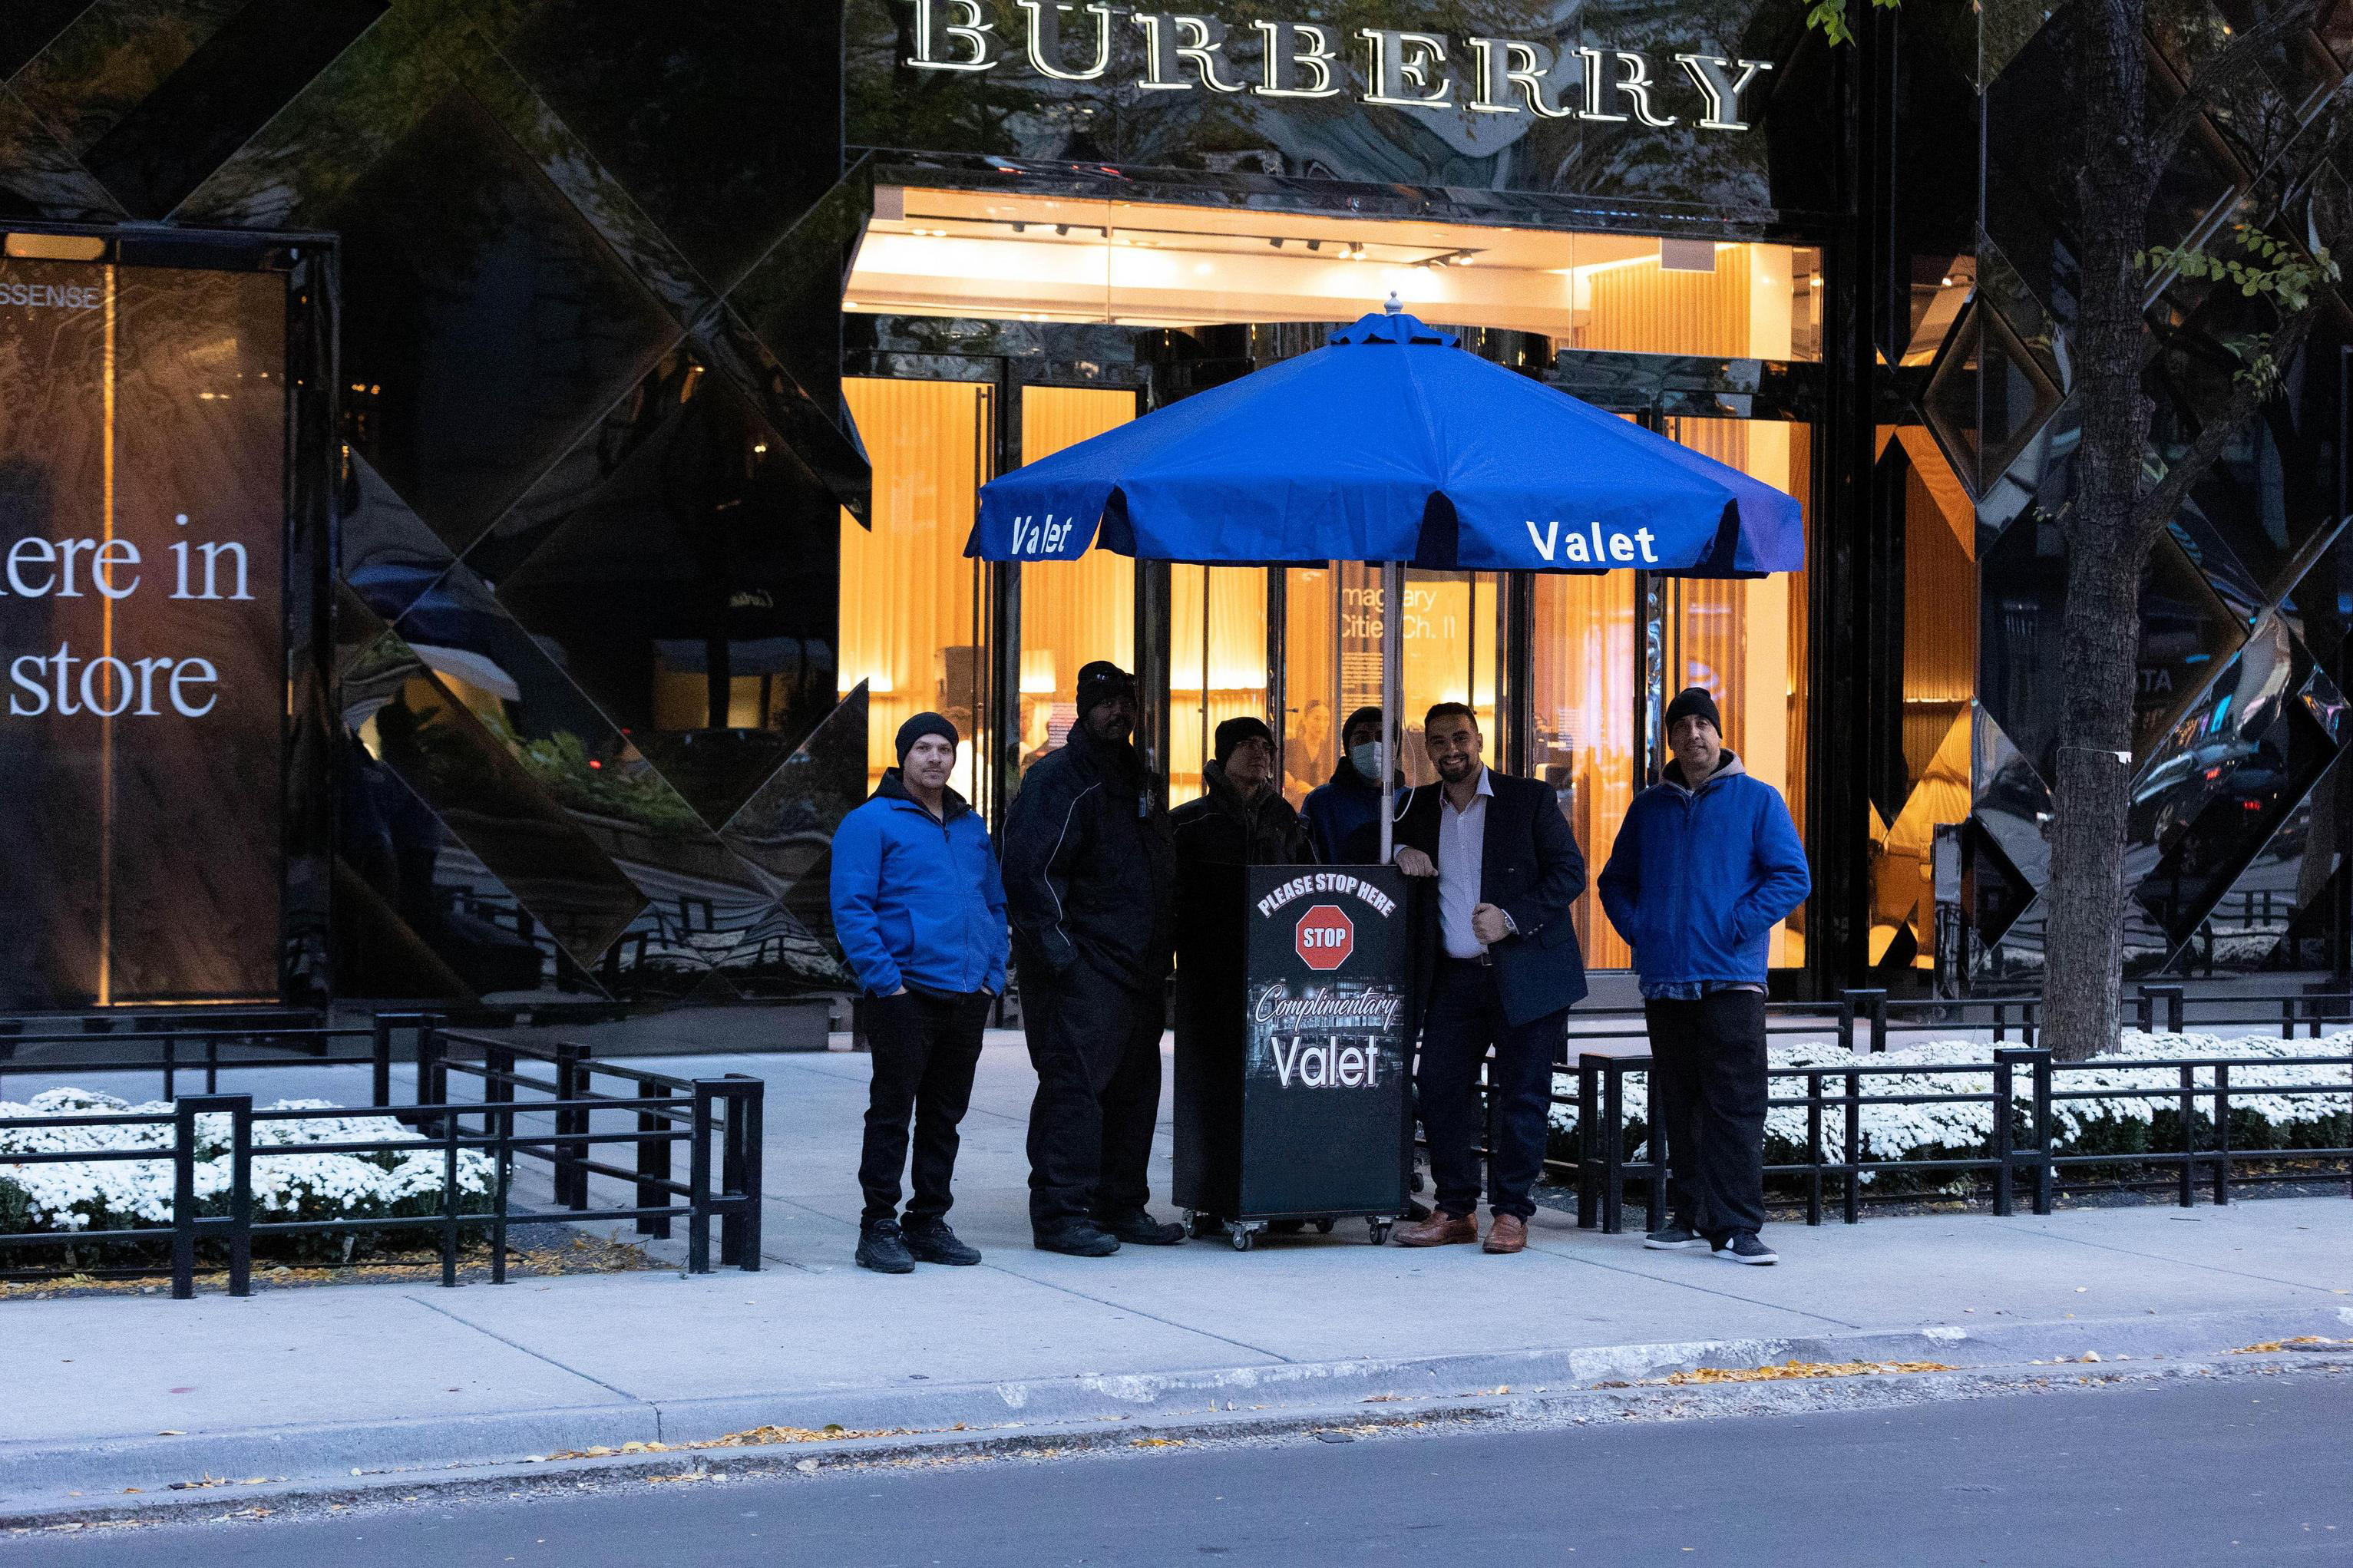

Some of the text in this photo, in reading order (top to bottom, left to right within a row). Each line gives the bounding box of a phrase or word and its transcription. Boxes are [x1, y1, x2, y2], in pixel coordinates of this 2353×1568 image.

[904, 0, 1775, 130] BURBERRY
[0, 513, 256, 601] ere in
[1010, 513, 1072, 555] Valet
[1525, 520, 1659, 564] Valet
[9, 640, 220, 718] store
[1257, 873, 1396, 918] PLEASE STOP HERE
[1303, 927, 1347, 948] STOP
[1254, 984, 1400, 1033] Complimentary
[1271, 1035, 1380, 1088] Valet
